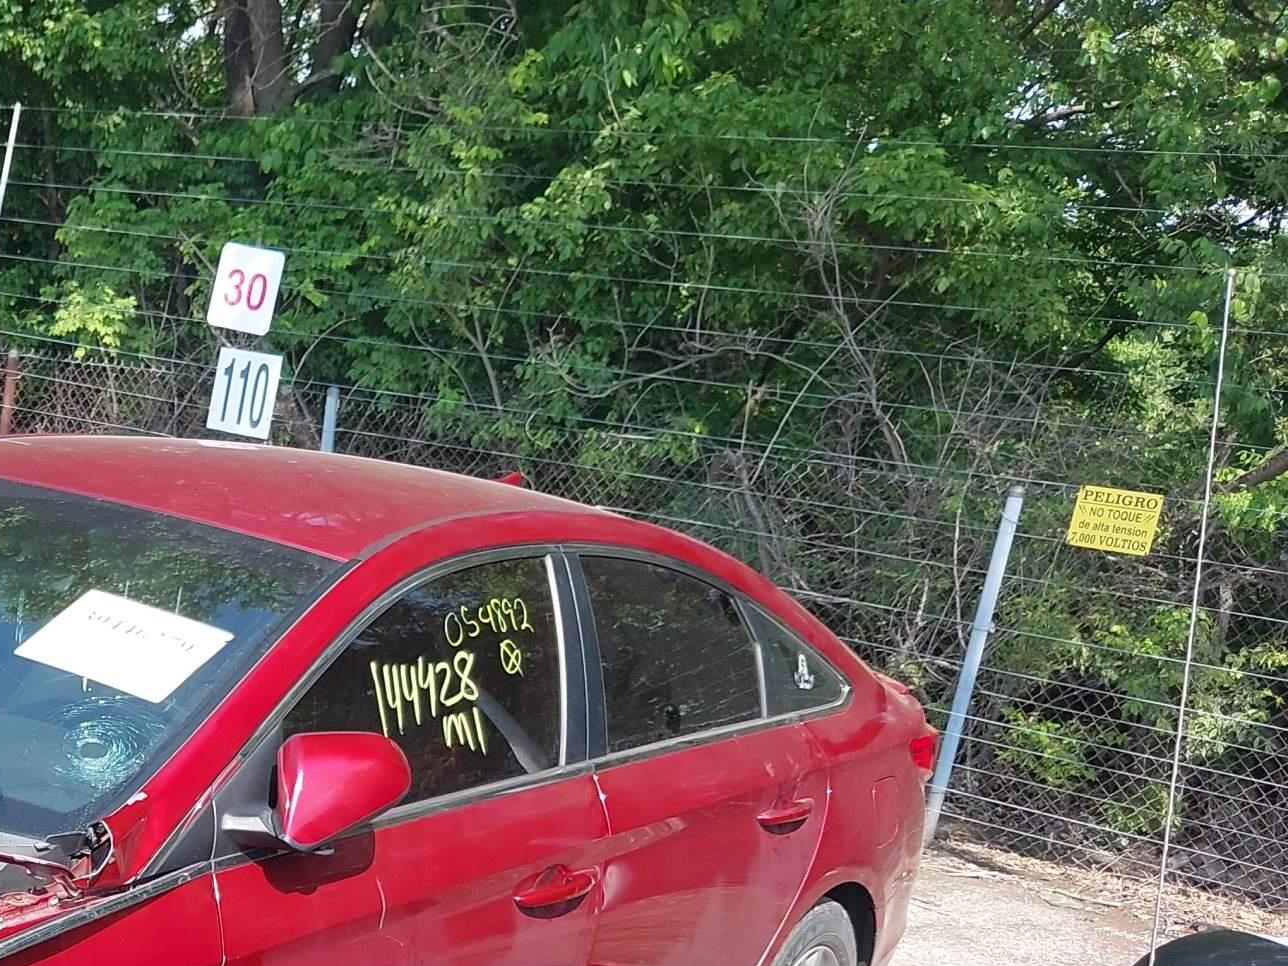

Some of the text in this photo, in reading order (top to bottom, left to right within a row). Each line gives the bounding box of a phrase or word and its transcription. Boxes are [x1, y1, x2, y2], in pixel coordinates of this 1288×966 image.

[223, 268, 268, 311] 30
[219, 357, 270, 429] 110
[1083, 489, 1159, 510] PELIGRO
[1078, 519, 1148, 538] de alta tension
[1098, 535, 1148, 552] VOLTIOS
